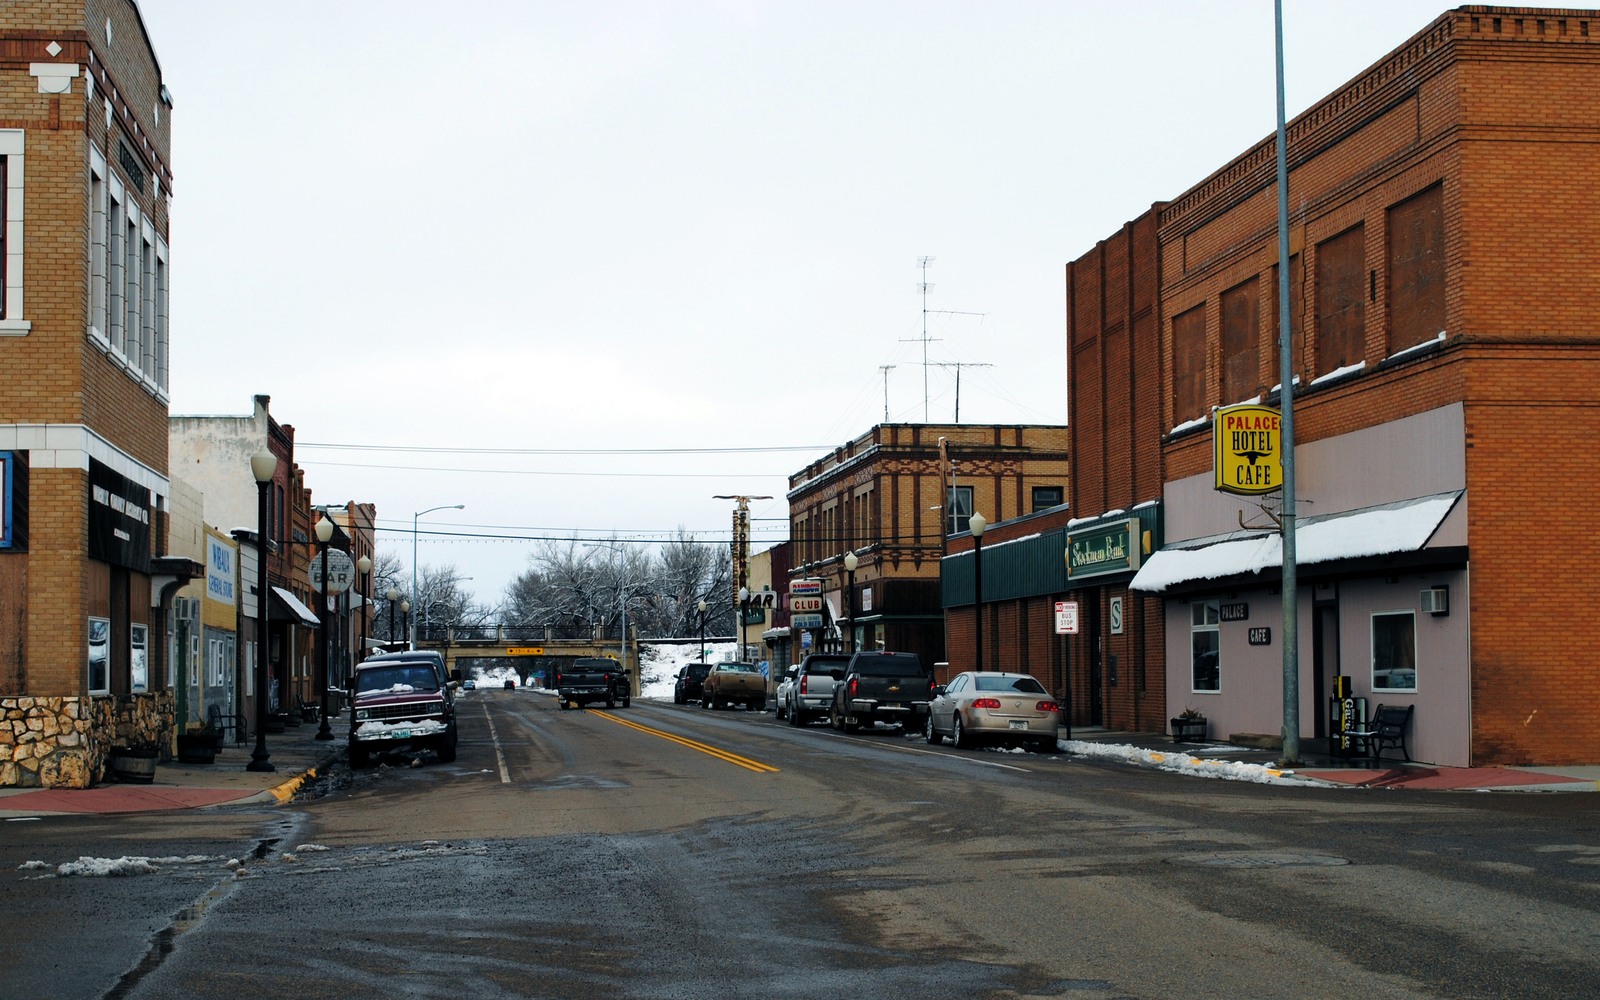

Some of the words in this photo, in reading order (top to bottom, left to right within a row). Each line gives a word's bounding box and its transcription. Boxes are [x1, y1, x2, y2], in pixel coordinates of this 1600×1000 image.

[1227, 416, 1278, 430] PALACE
[1232, 431, 1273, 451] HOTEL
[1237, 465, 1271, 485] CAFE
[1072, 541, 1105, 567] Stockman
[1105, 533, 1126, 562] Bank
[794, 600, 820, 610] CLUB
[1222, 605, 1245, 619] PALACE
[1250, 629, 1267, 642] CAFE
